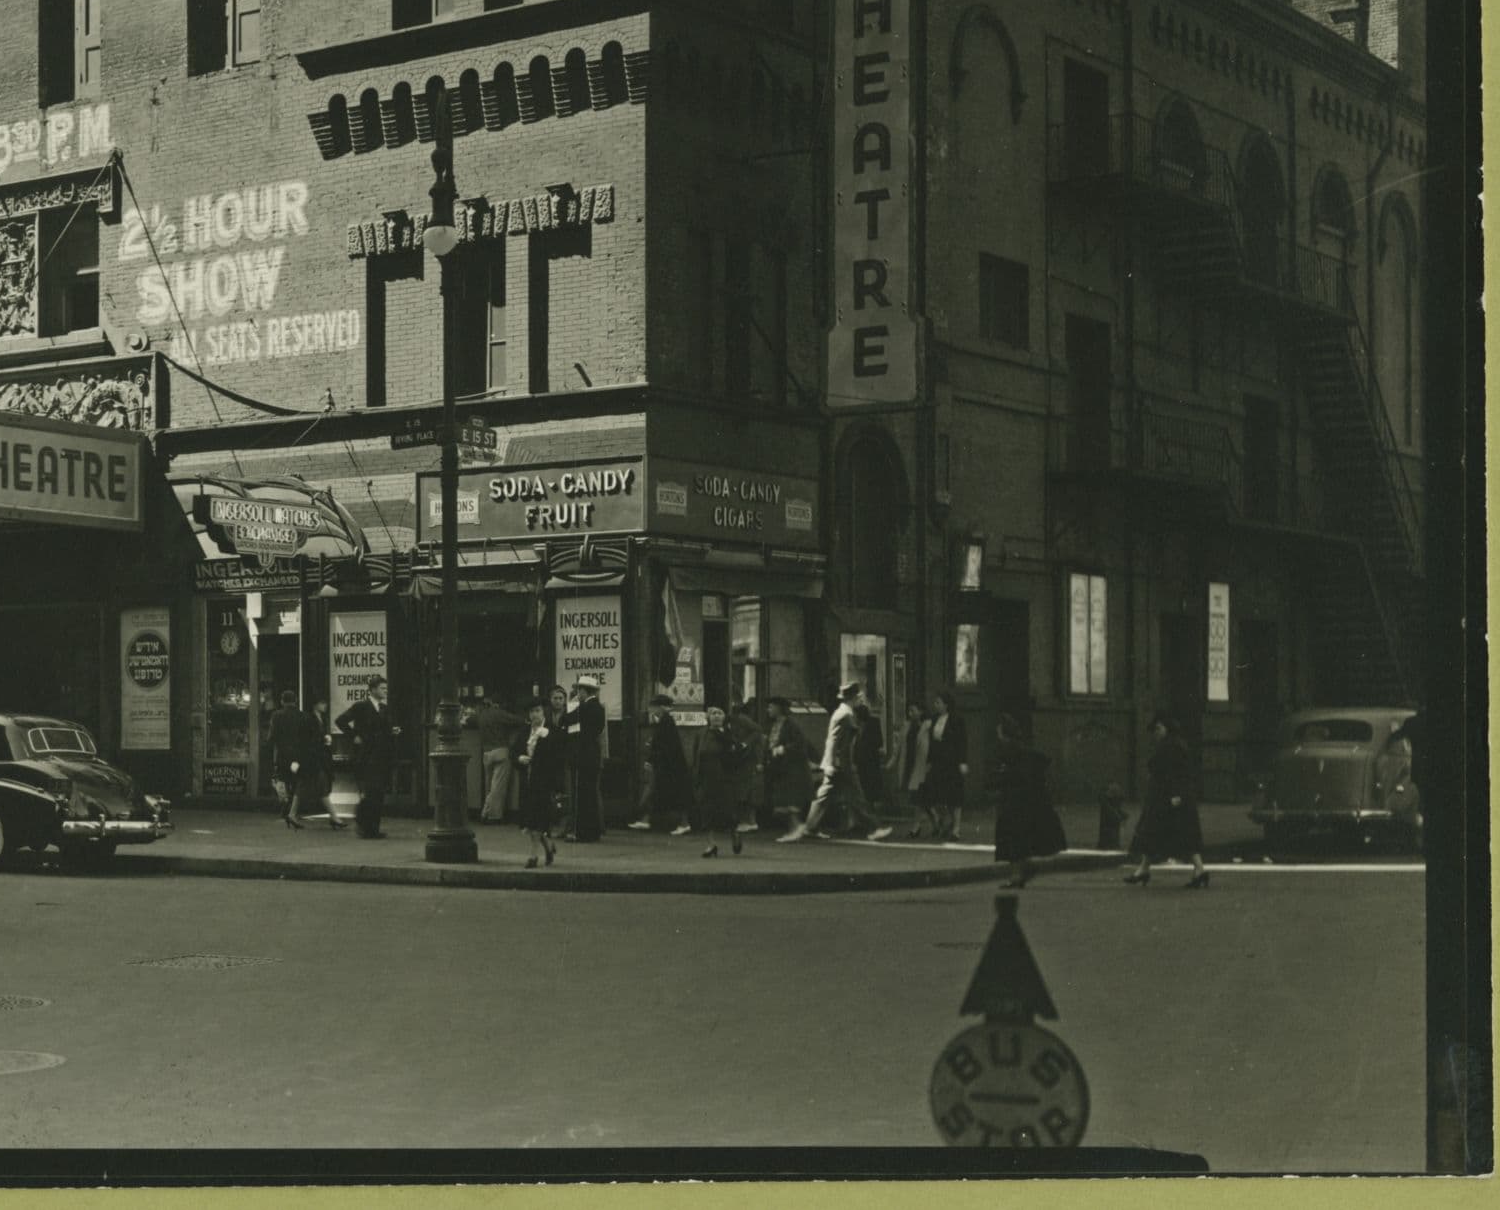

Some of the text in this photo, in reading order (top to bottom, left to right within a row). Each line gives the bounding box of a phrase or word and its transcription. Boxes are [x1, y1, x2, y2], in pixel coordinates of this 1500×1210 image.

[182, 179, 309, 251] HOUR
[136, 245, 285, 326] SHOW
[170, 310, 361, 367] ALL SEATS RESERVED
[462, 429, 495, 446] E 15 ST
[213, 500, 320, 528] INGERSOLL WATCHES
[526, 502, 595, 530] FRUIT
[714, 506, 764, 530] CIGARS
[243, 575, 300, 588] EXCHANGED
[560, 611, 619, 629] INGERSOLL
[333, 631, 386, 647] INGERSOLL
[562, 633, 619, 650] WATCHES
[333, 652, 385, 668] WATCHES
[564, 656, 616, 670] EXCHANGED
[948, 1032, 1069, 1089] BUS
[940, 1102, 1070, 1147] STOP
